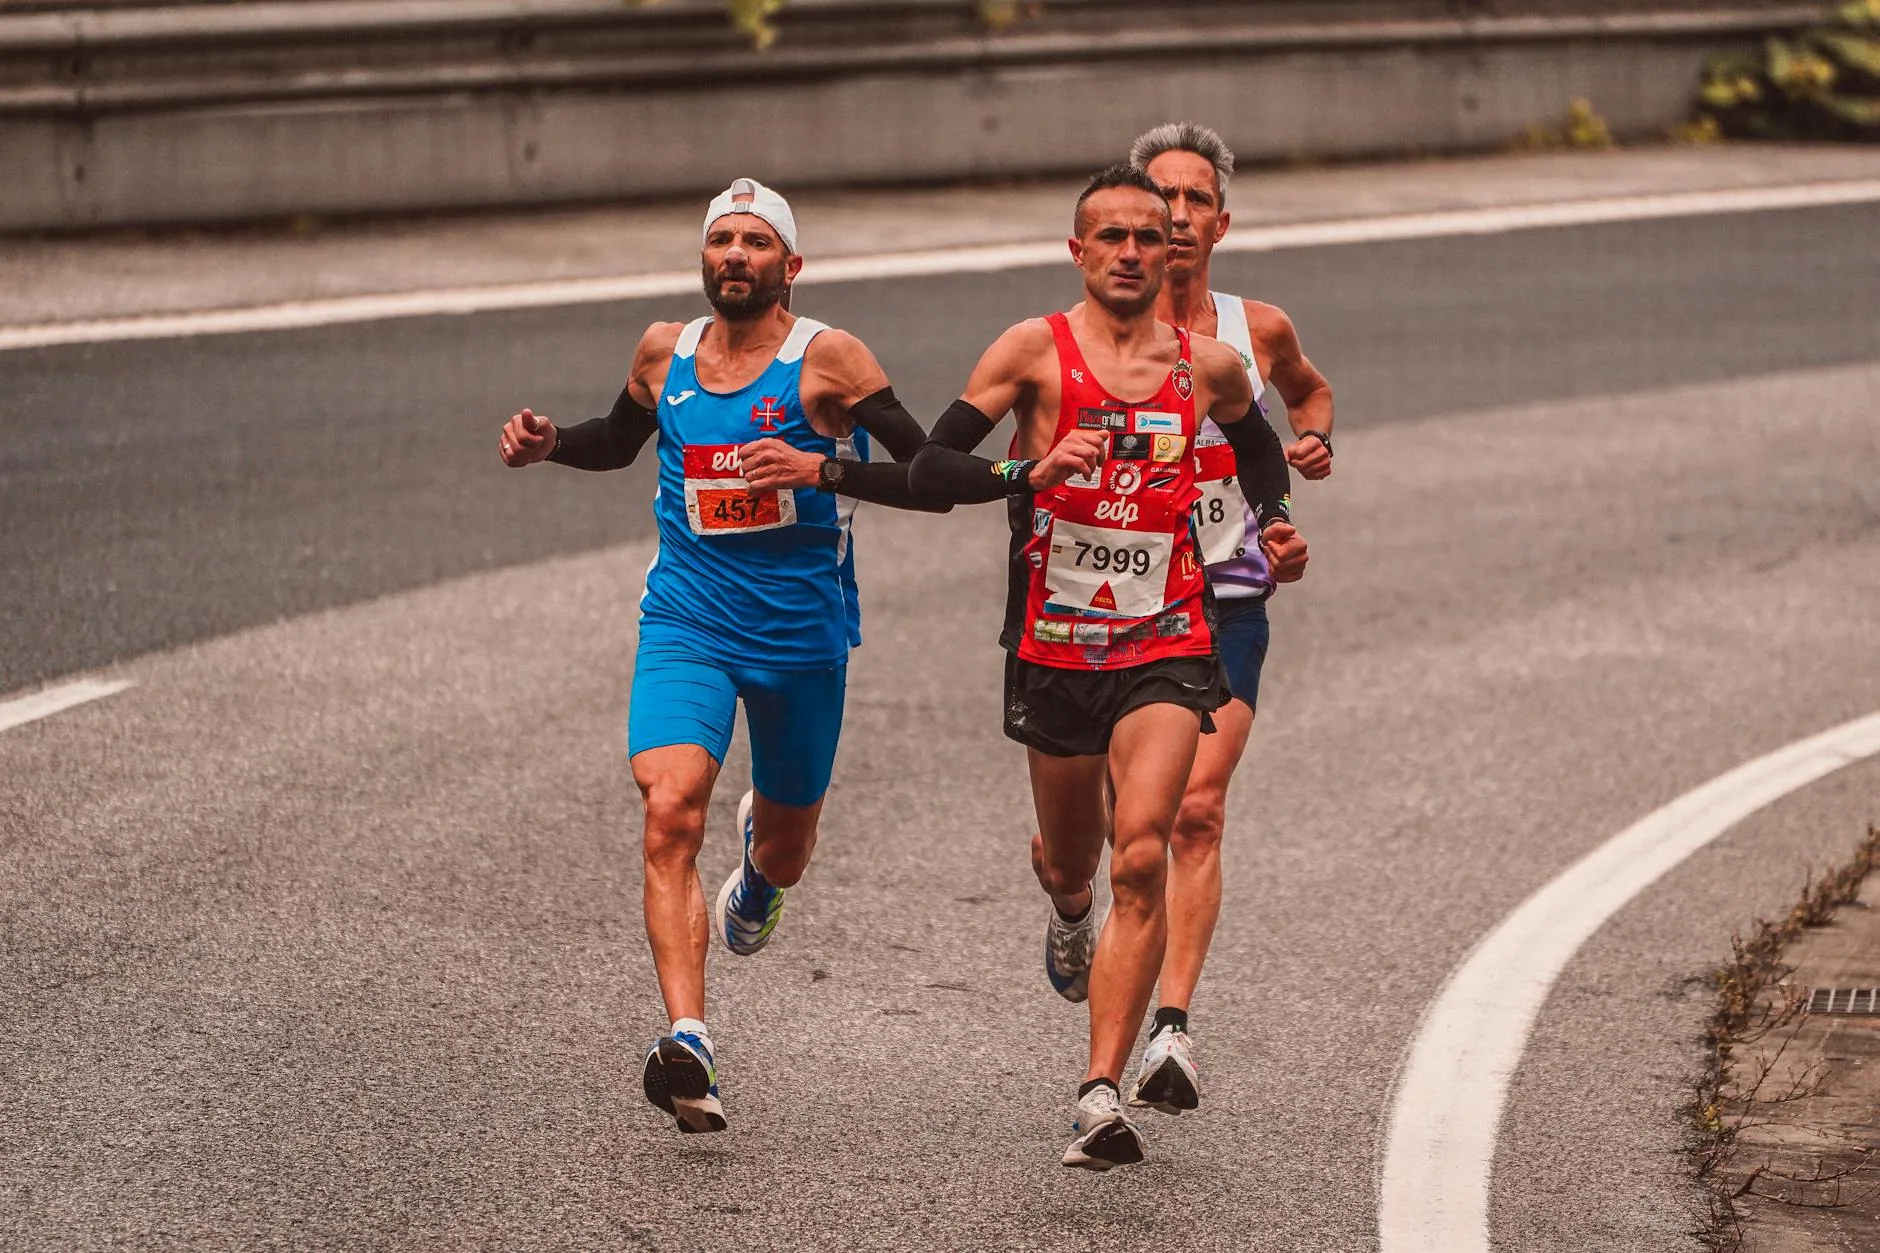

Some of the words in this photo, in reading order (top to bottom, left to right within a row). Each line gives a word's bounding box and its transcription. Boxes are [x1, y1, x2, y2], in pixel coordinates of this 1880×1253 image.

[714, 497, 760, 521] 457
[1094, 495, 1139, 528] edp
[1074, 541, 1150, 576] 7999
